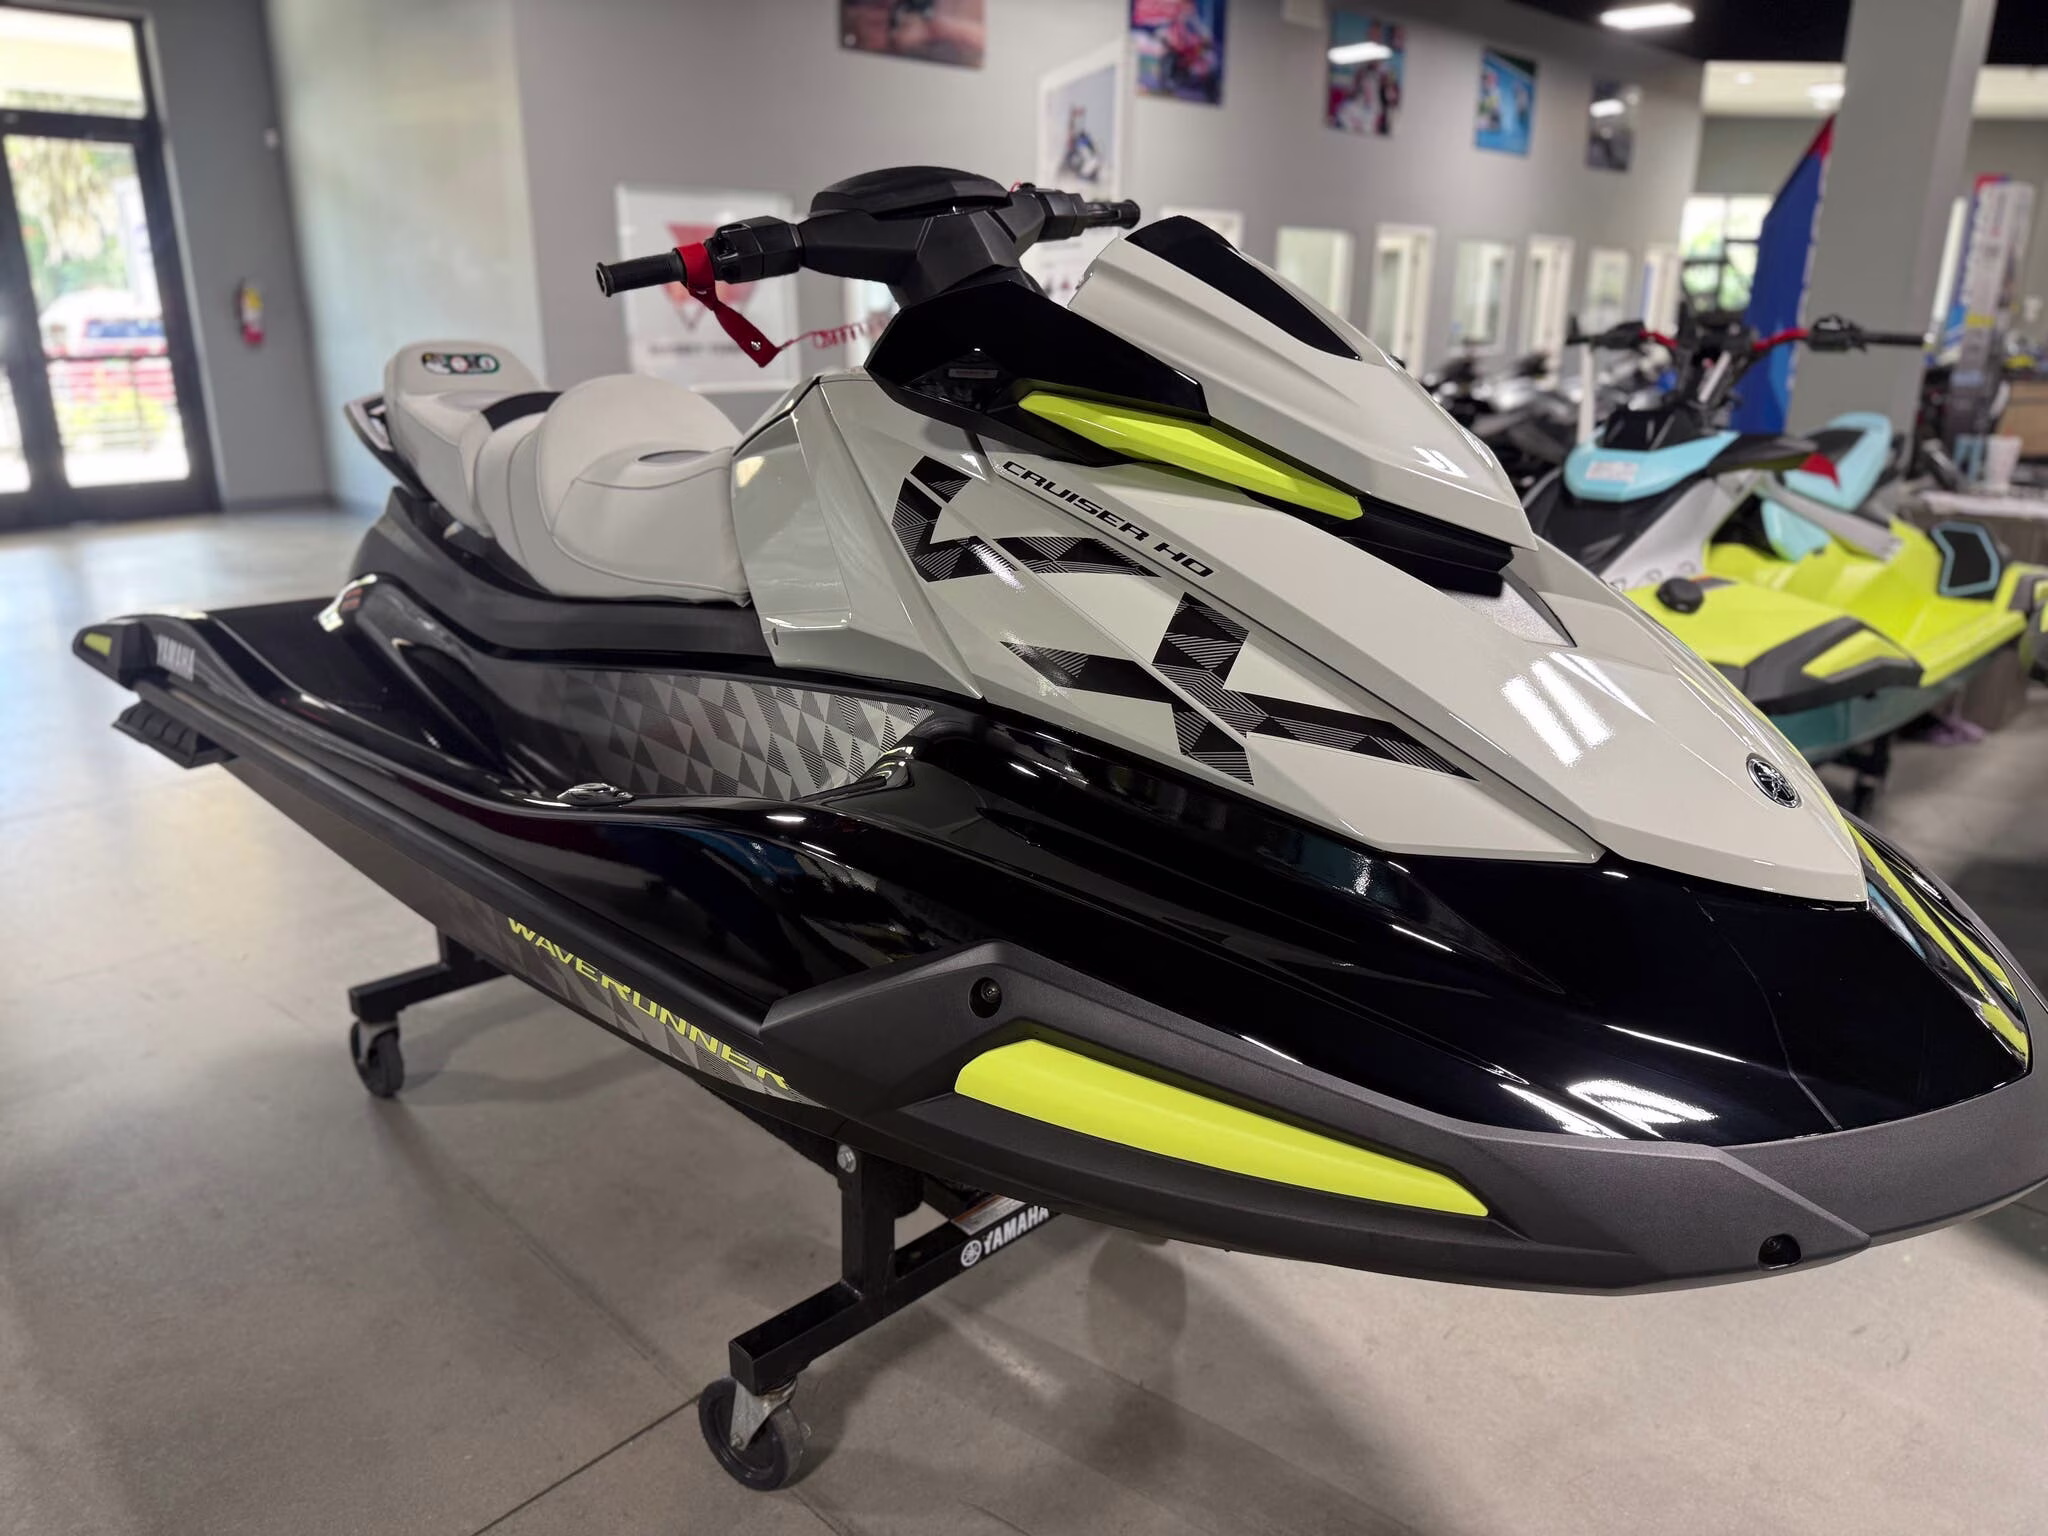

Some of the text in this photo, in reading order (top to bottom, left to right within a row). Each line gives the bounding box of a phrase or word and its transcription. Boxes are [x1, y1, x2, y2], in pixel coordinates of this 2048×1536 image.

[1003, 461, 1214, 578] CRUISER HO
[508, 917, 789, 1090] WAVERUNNER
[983, 1205, 1050, 1255] YAMAHA
